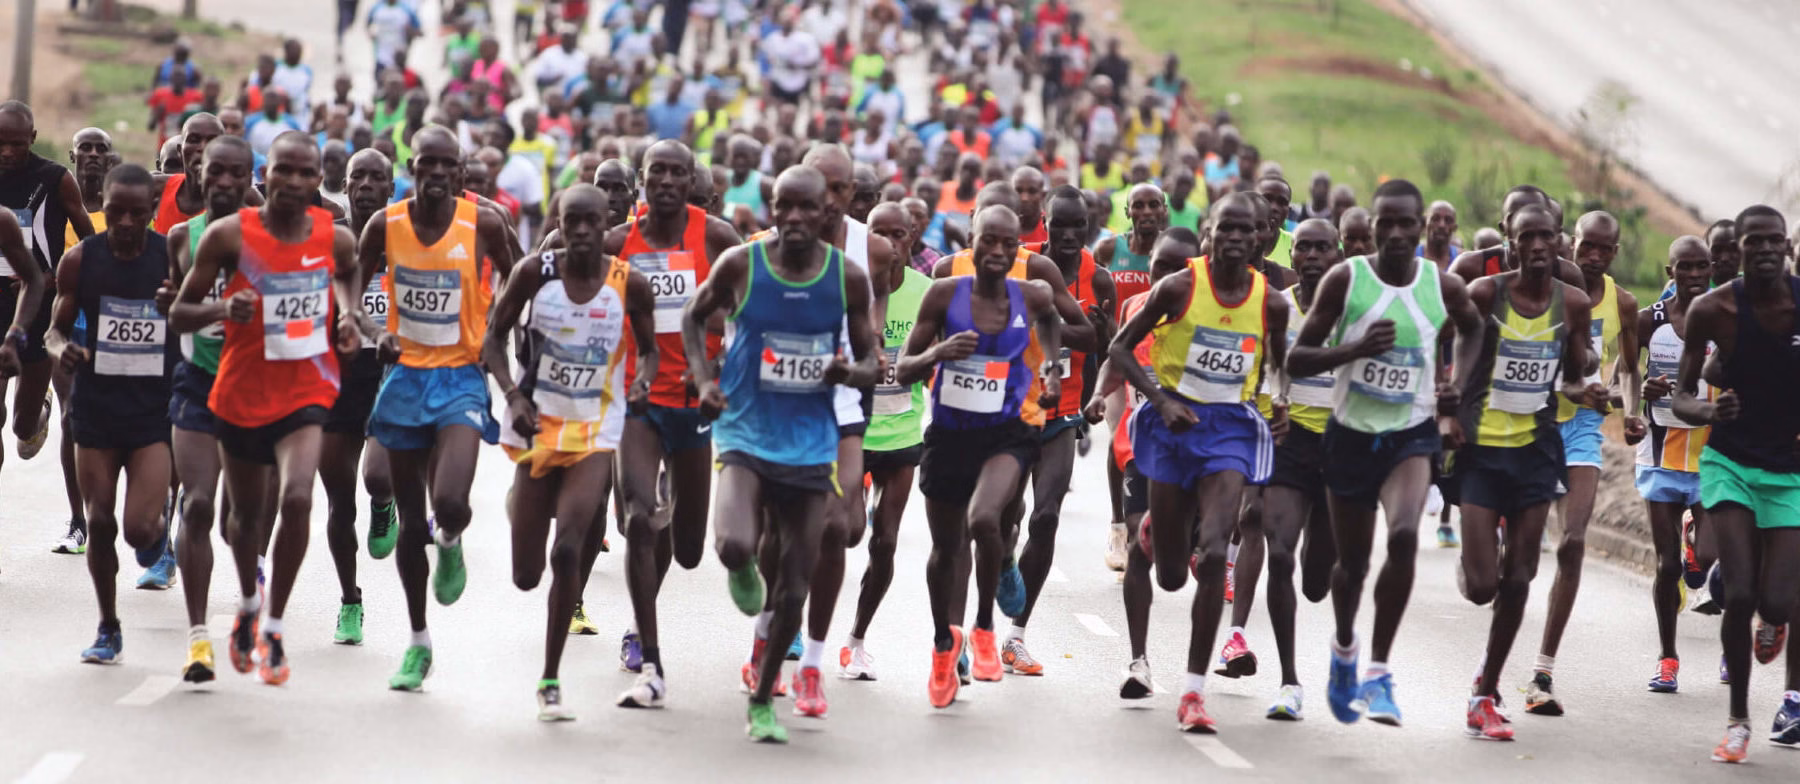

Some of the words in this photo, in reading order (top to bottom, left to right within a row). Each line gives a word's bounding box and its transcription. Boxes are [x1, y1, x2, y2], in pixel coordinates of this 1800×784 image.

[650, 274, 685, 296] 630
[274, 293, 321, 320] 4262
[364, 294, 389, 315] 56
[403, 288, 451, 313] 4597
[107, 319, 156, 343] 2652
[772, 357, 823, 380] 4168
[1196, 349, 1244, 374] 4643
[1504, 361, 1550, 382] 5881
[548, 361, 597, 388] 5677
[1363, 361, 1410, 390] 6199
